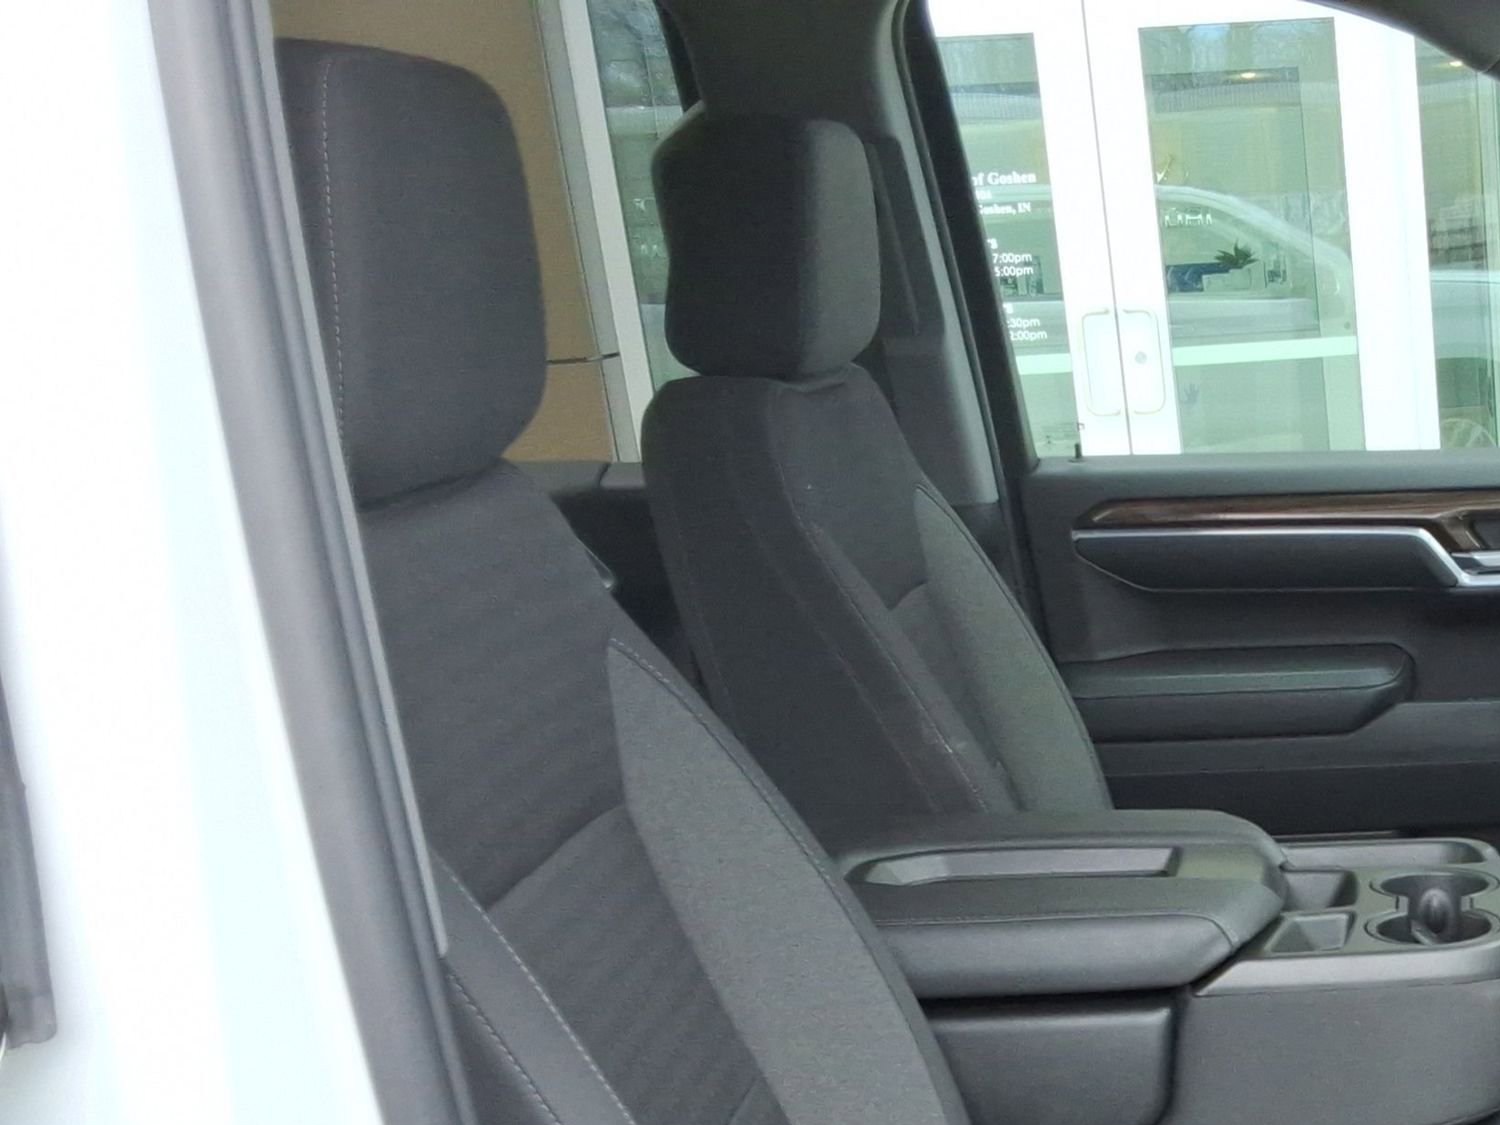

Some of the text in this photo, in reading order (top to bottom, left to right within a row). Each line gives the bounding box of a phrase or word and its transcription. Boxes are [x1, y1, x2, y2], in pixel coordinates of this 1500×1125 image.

[987, 171, 1037, 185] Goshen
[1018, 202, 1032, 213] IN
[992, 252, 1033, 264] 7:00pm
[994, 266, 1034, 277] 5:00pm
[1007, 318, 1041, 329] :30pm
